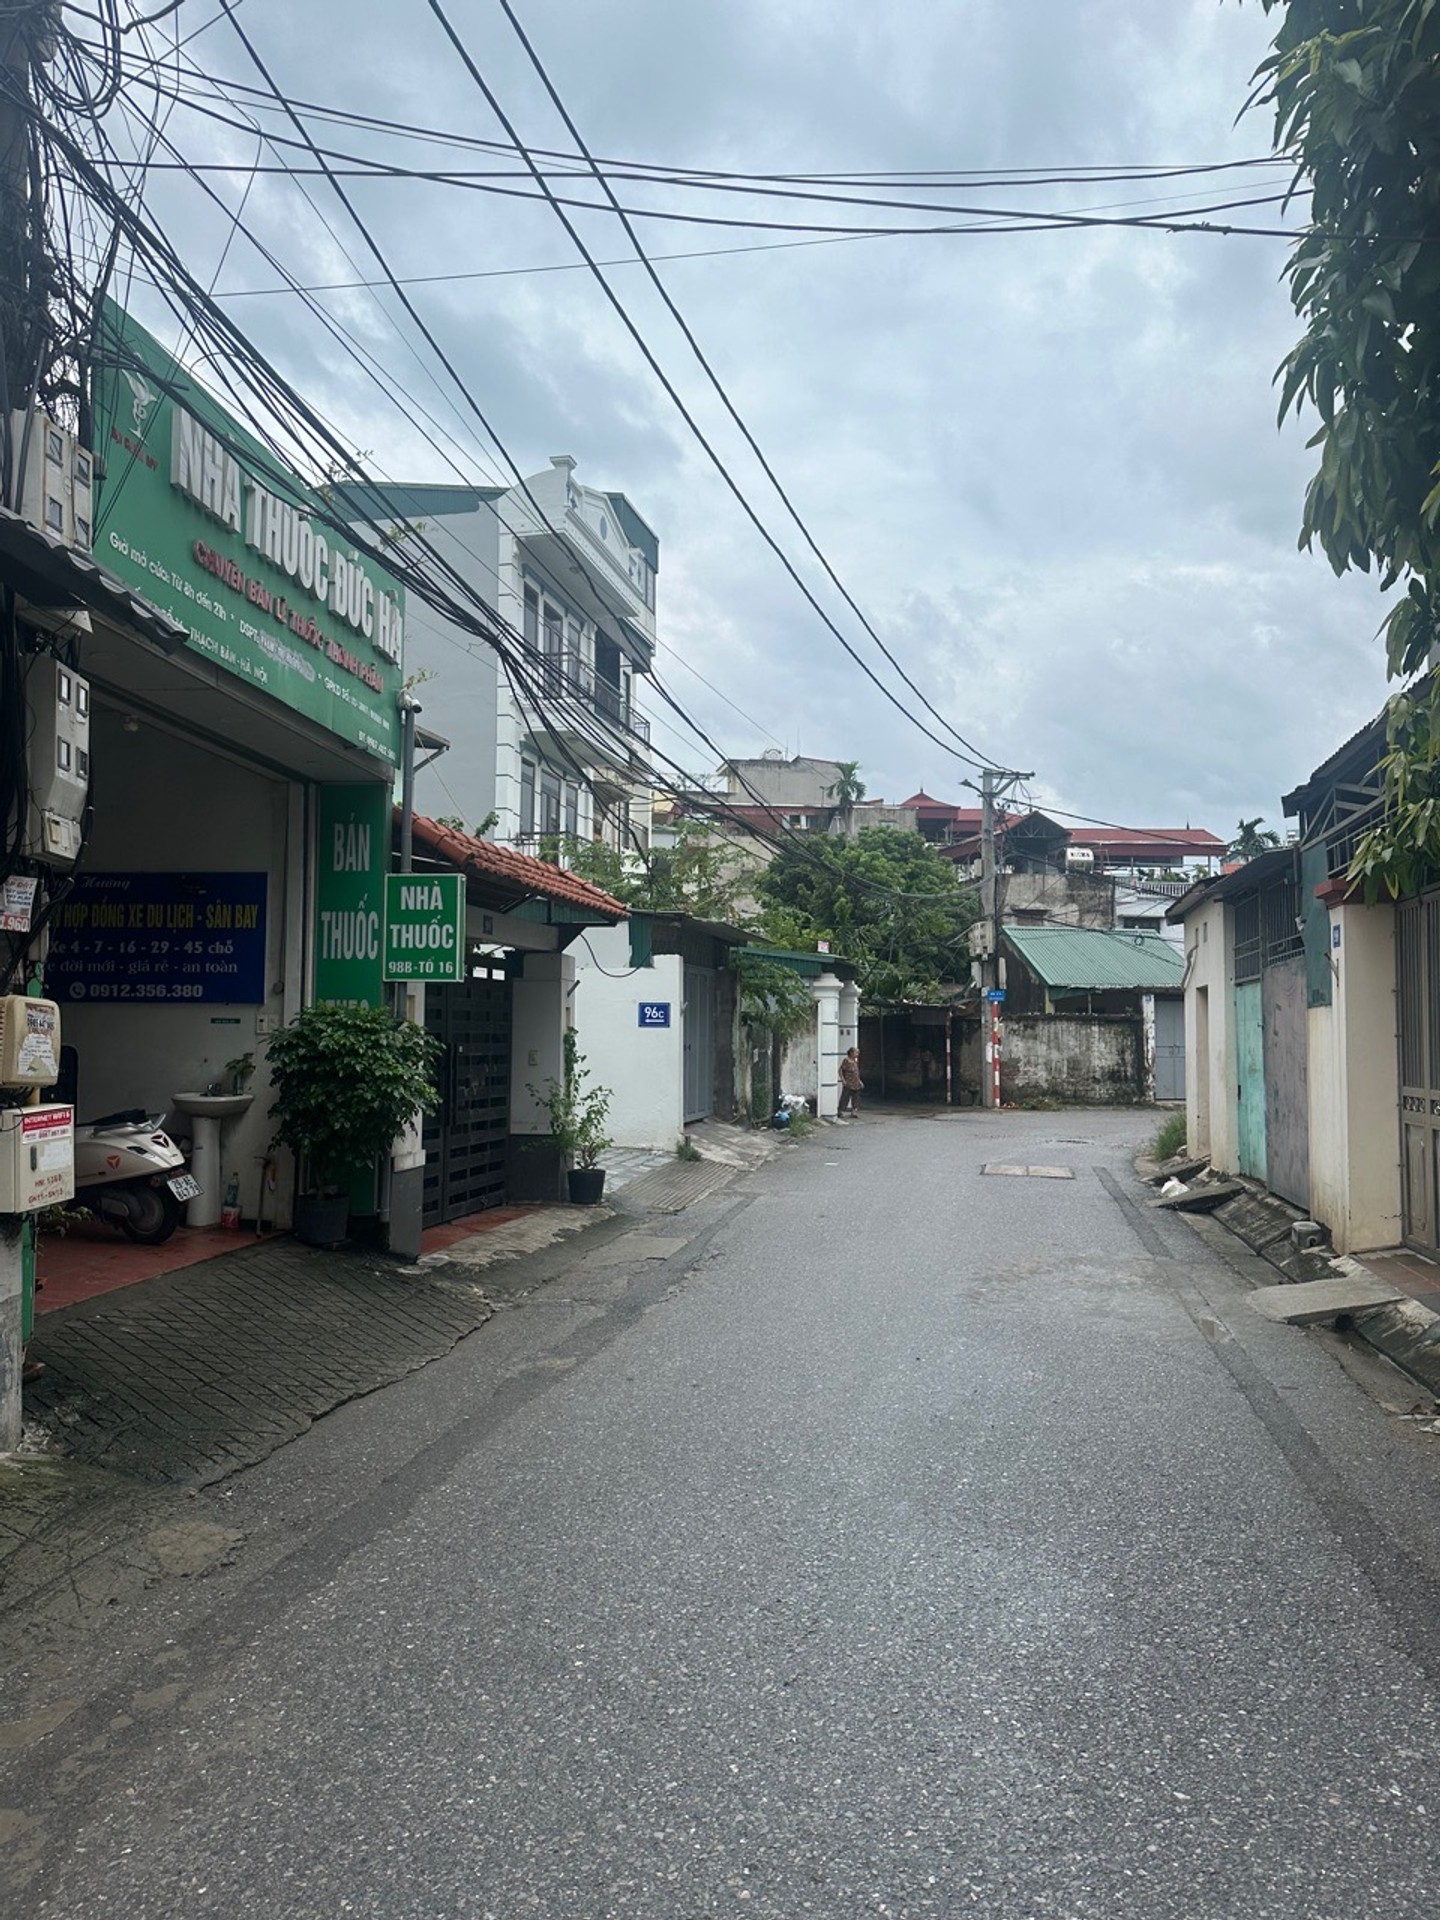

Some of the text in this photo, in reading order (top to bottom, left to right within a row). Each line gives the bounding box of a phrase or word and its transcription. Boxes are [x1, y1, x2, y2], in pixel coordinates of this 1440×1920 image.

[110, 532, 128, 555] Giờ
[130, 551, 147, 568] mở
[171, 572, 182, 592] Từ
[196, 592, 212, 611] đến
[246, 579, 273, 613] BÁN
[329, 550, 373, 637] ĐỨC
[190, 626, 219, 654] THẠCH
[333, 813, 370, 871] BÁN
[401, 880, 443, 910] NHÀ
[91, 895, 124, 928] ĐỒNG
[128, 904, 144, 928] XE
[147, 904, 163, 928] DU
[167, 904, 194, 933] LỊCH
[206, 899, 232, 928] SÂN
[235, 904, 259, 928] BAY
[321, 893, 379, 960] THUỐC
[70, 941, 80, 954] 4
[94, 941, 103, 954] 7
[119, 941, 136, 954] 16
[151, 941, 169, 954] 29
[183, 941, 203, 954] 45
[208, 939, 233, 954] chỗ
[390, 915, 454, 949] THUỐC
[60, 959, 83, 973] đời
[87, 959, 115, 973] mới
[128, 959, 150, 974] giá
[182, 963, 200, 973] an
[205, 960, 238, 973] toàn
[439, 961, 453, 973] 16
[90, 983, 204, 997] 0912.356.380
